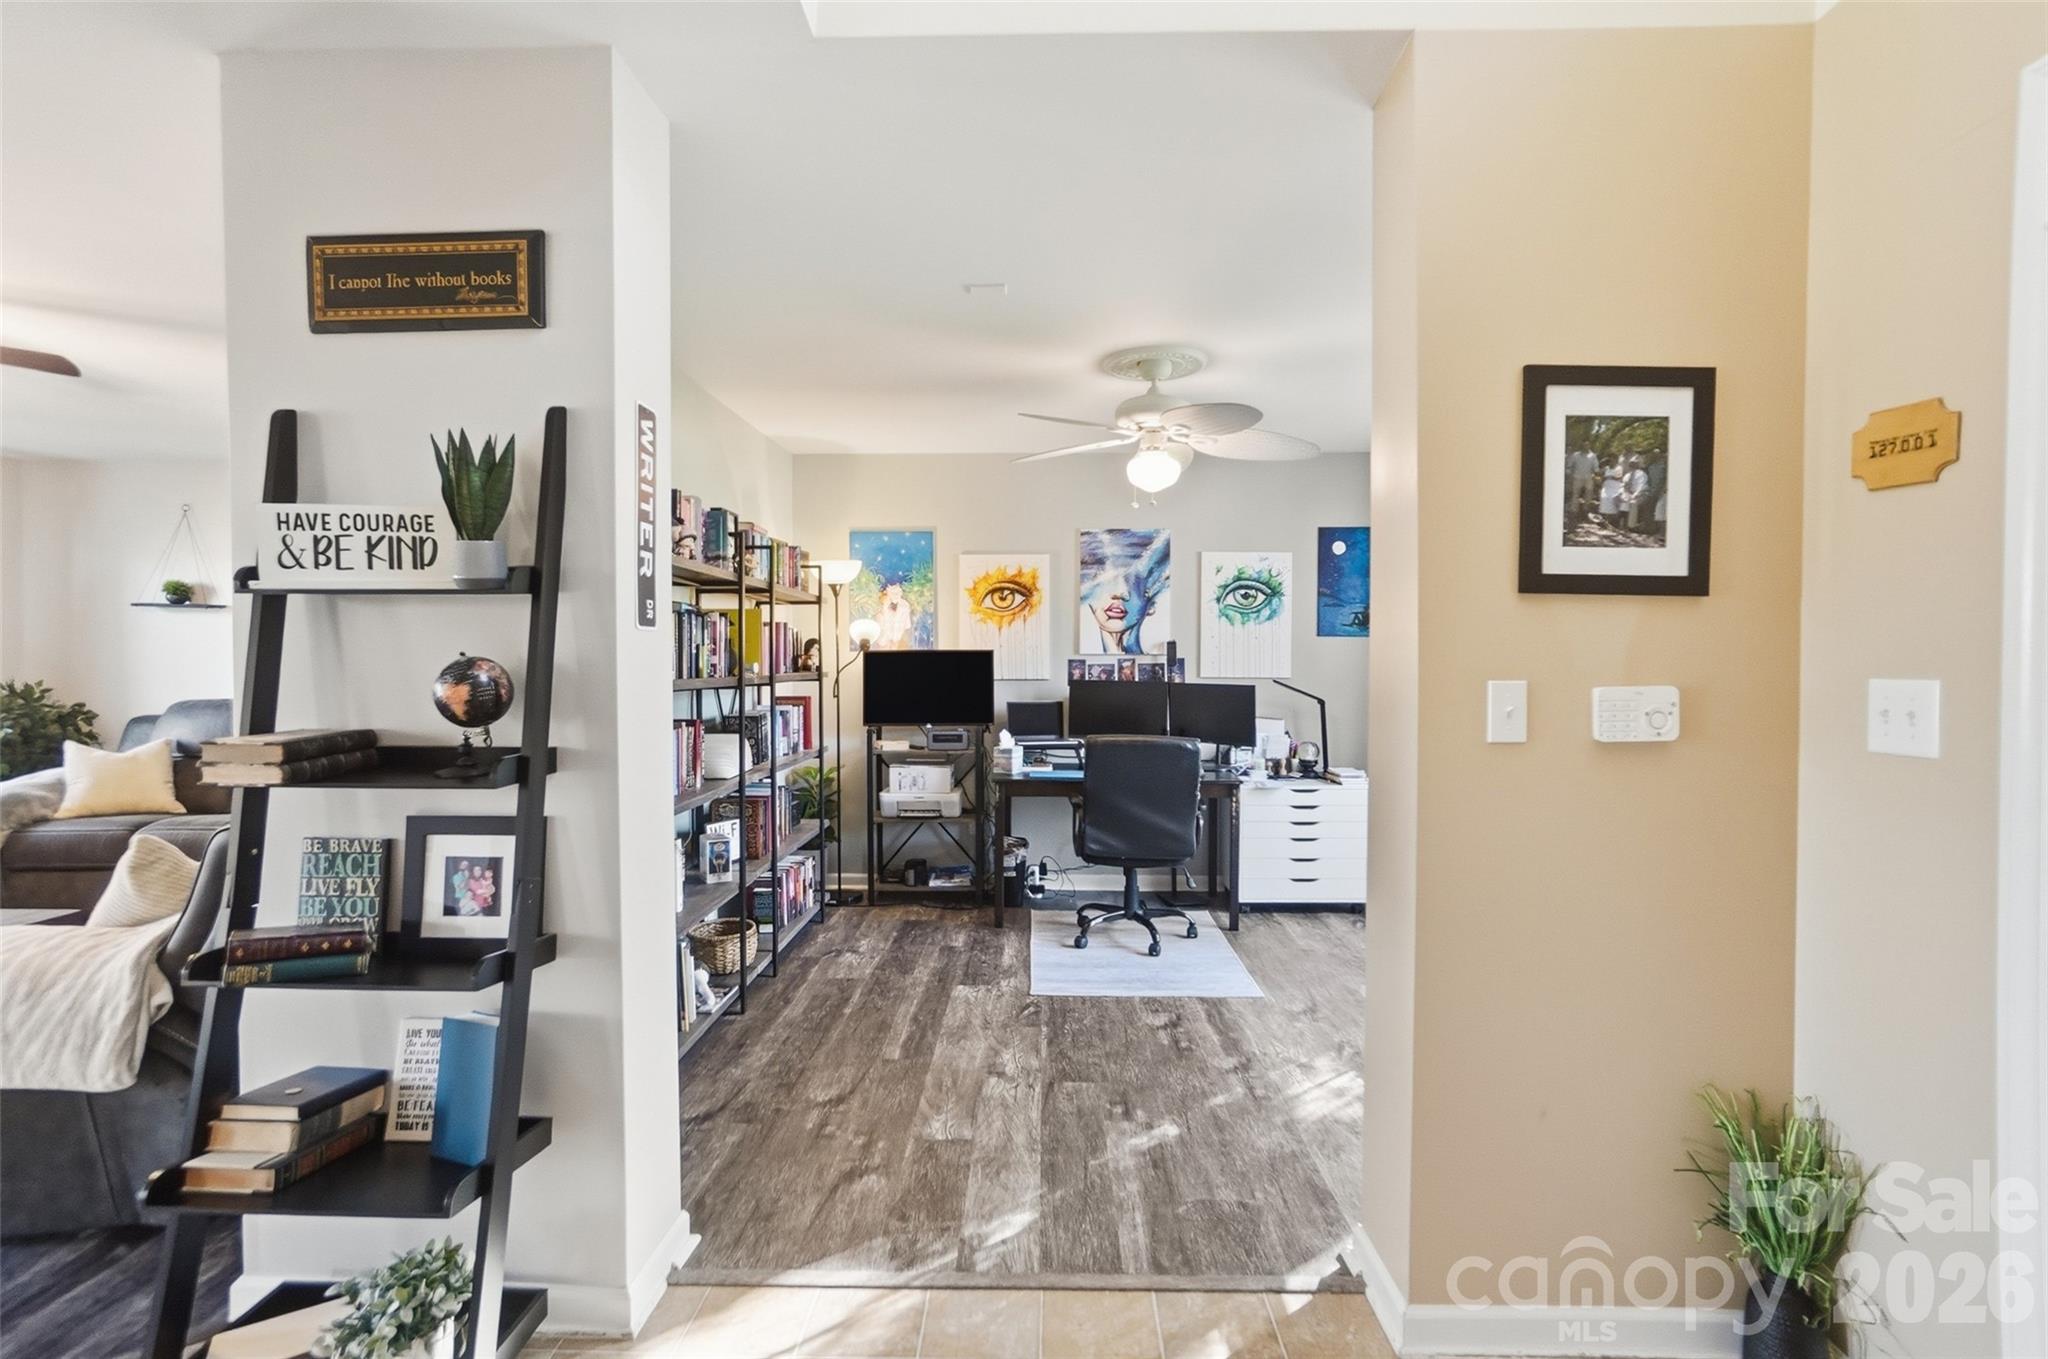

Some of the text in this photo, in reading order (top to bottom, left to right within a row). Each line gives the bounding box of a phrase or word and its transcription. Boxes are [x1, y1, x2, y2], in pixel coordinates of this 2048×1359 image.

[328, 273, 336, 290] I
[414, 271, 467, 288] without
[470, 270, 513, 286] books
[276, 512, 436, 533] HAVE COURAGE
[639, 418, 654, 619] WRITER DR
[276, 533, 439, 570] & BE KIND
[303, 838, 383, 853] BE BRAVE
[302, 854, 382, 877] REACH
[300, 878, 380, 897] LIVE FLY
[299, 897, 380, 916] BE YOU
[406, 1028, 424, 1039] LIVE
[394, 1121, 421, 1131] TODAY
